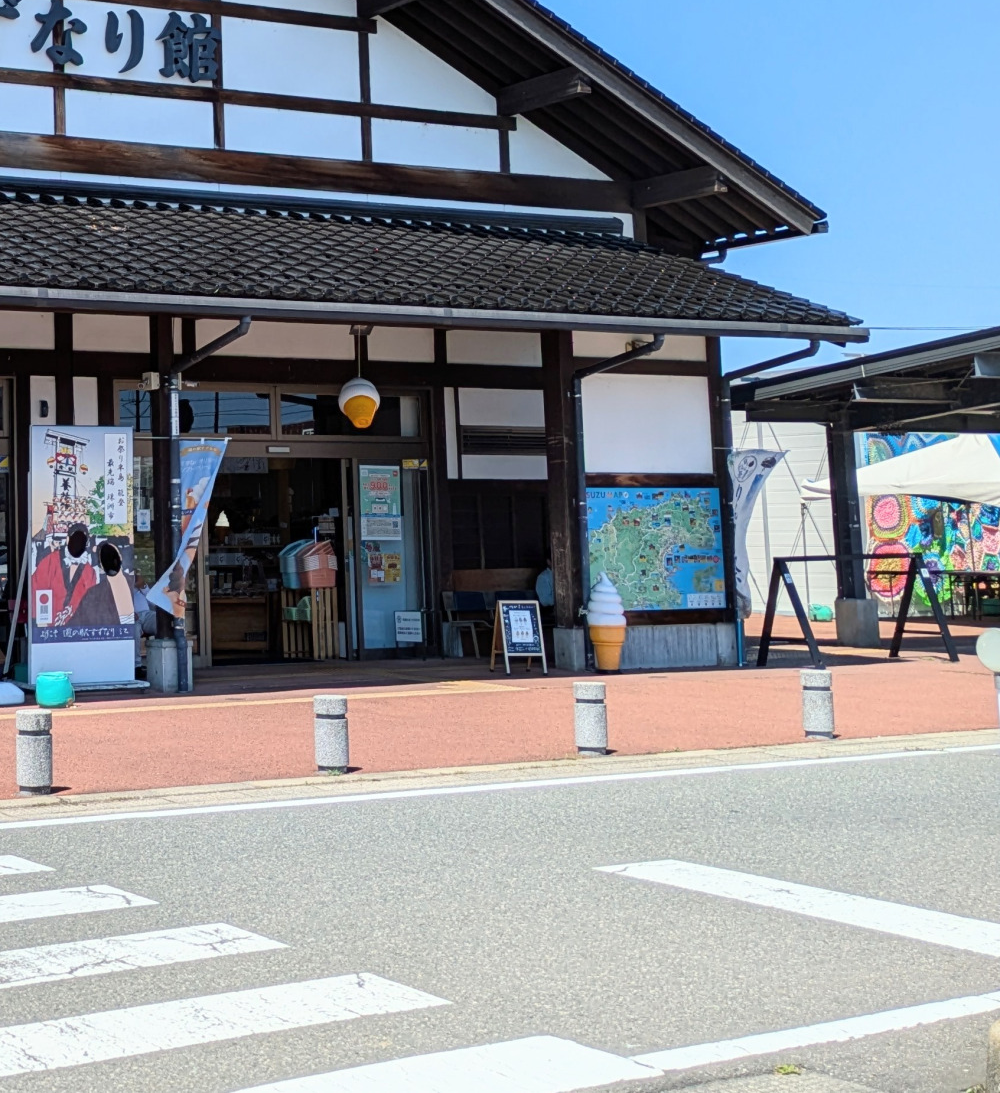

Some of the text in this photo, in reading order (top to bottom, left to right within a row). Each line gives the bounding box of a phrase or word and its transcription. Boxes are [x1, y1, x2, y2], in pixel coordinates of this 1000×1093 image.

[117, 488, 126, 507] 能登
[586, 491, 606, 499] SUZU
[106, 493, 116, 521] 珠洲市
